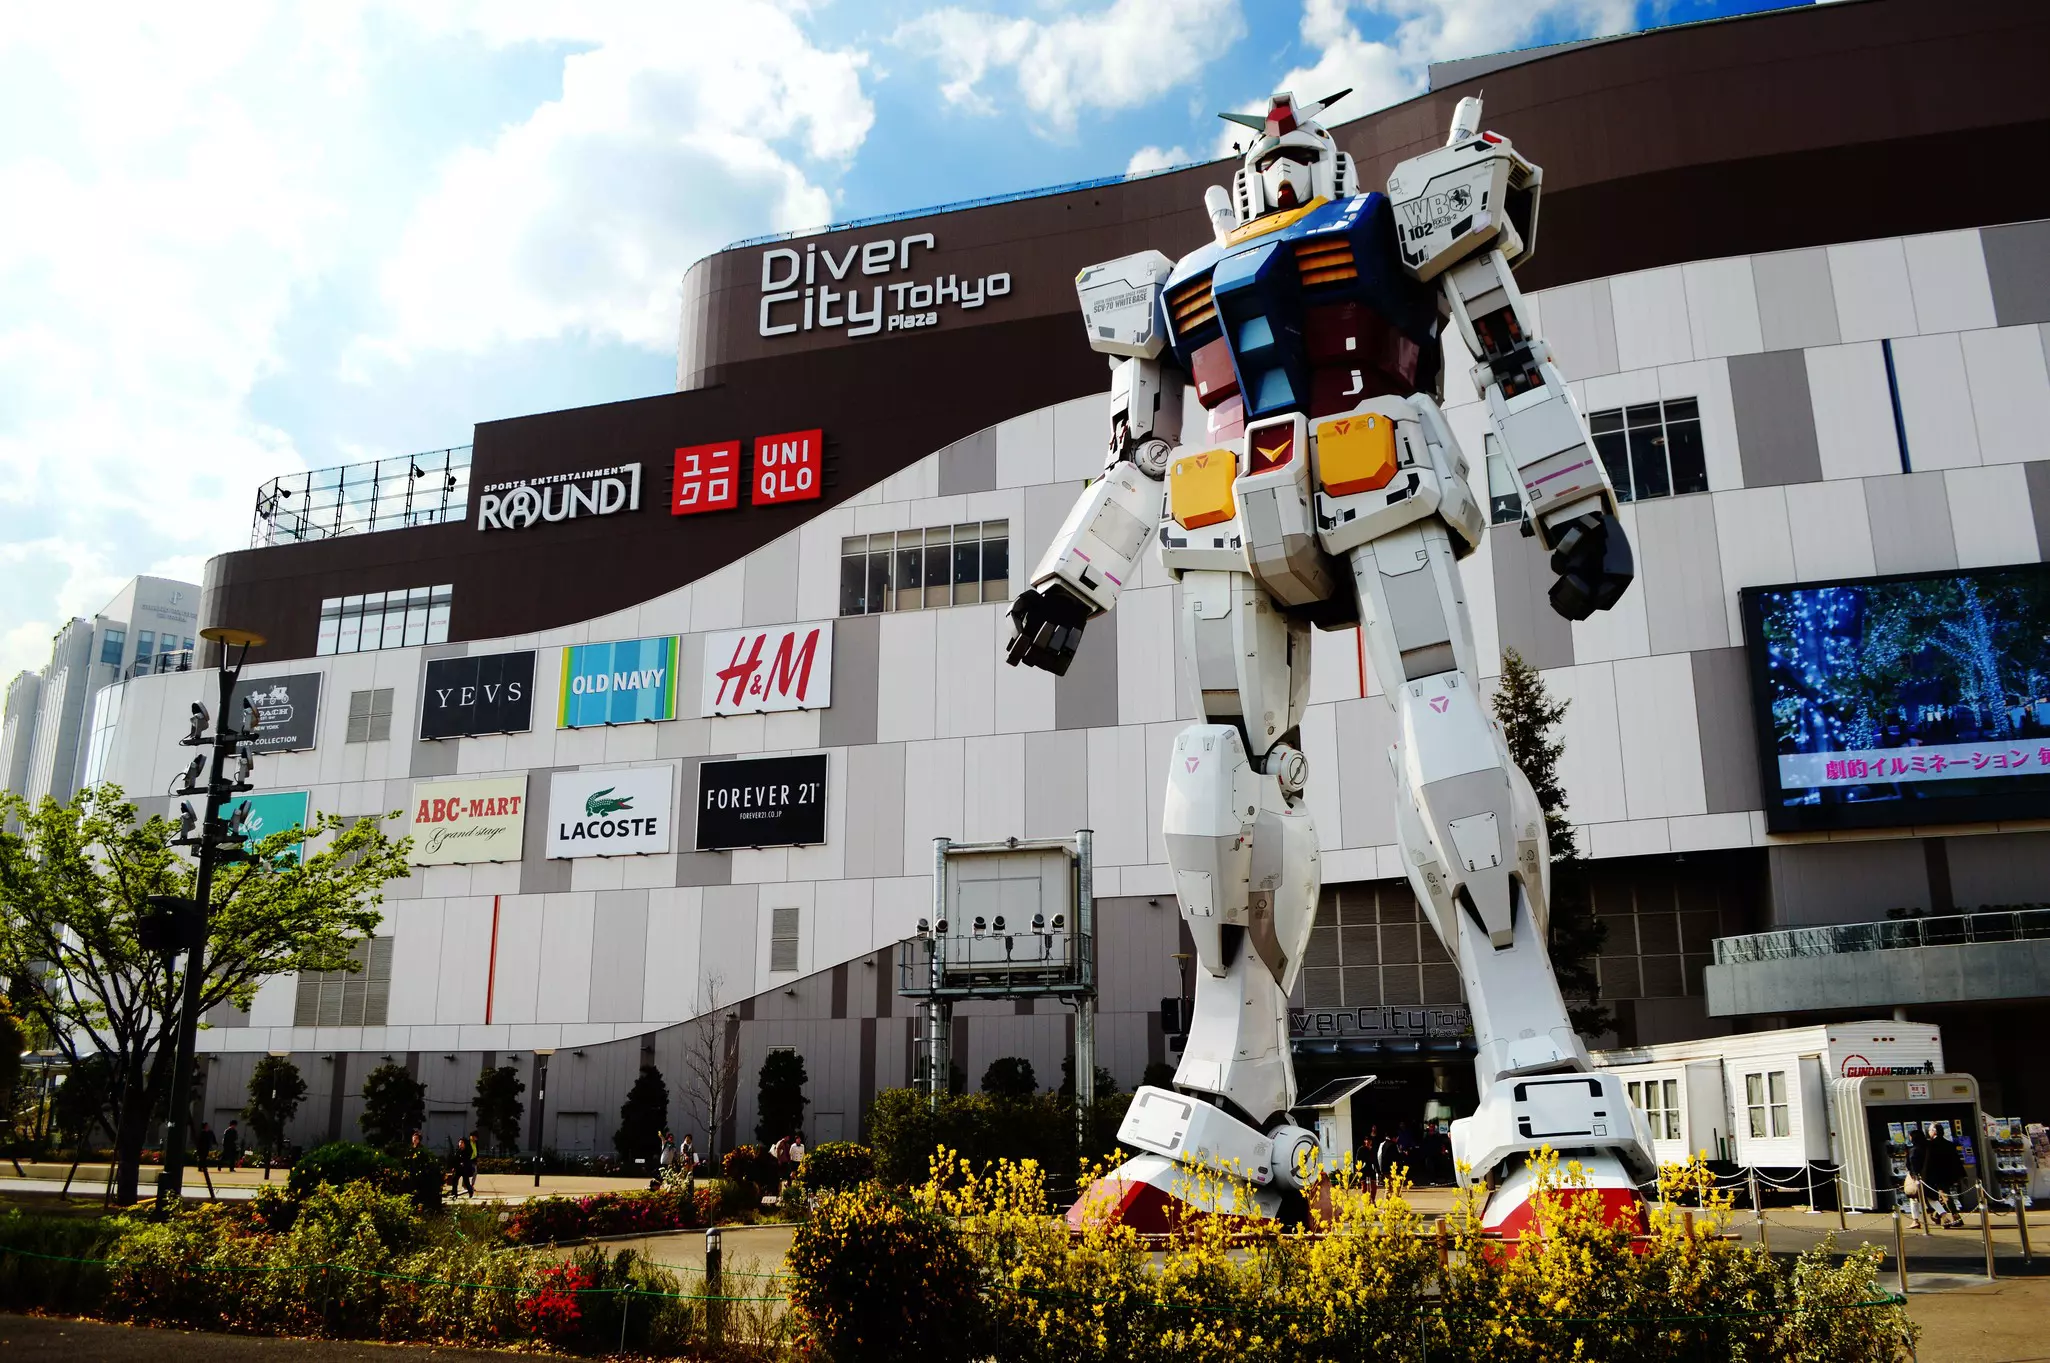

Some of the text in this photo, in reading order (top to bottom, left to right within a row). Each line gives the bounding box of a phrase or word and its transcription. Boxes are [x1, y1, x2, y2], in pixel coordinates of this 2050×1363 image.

[1408, 222, 1434, 241] 102
[761, 232, 935, 293] Diver
[759, 285, 883, 337] City
[888, 311, 938, 332] Plaza
[762, 439, 809, 467] UNI
[484, 466, 626, 493] SPORTS ENTERTAINMENT
[760, 467, 812, 498] QLO
[716, 628, 820, 707] H&M
[436, 682, 522, 708] YEVS
[572, 668, 665, 695] OLD NAVY
[255, 736, 297, 745] COLLECTION
[1826, 749, 2029, 780] 劇的イルミネーション
[415, 796, 522, 824] ABC-MART
[707, 785, 790, 810] FOREVER
[739, 810, 783, 820] FOREVER21.CO.JP
[425, 826, 507, 854] Grand stage
[560, 817, 657, 841] LACOSTE
